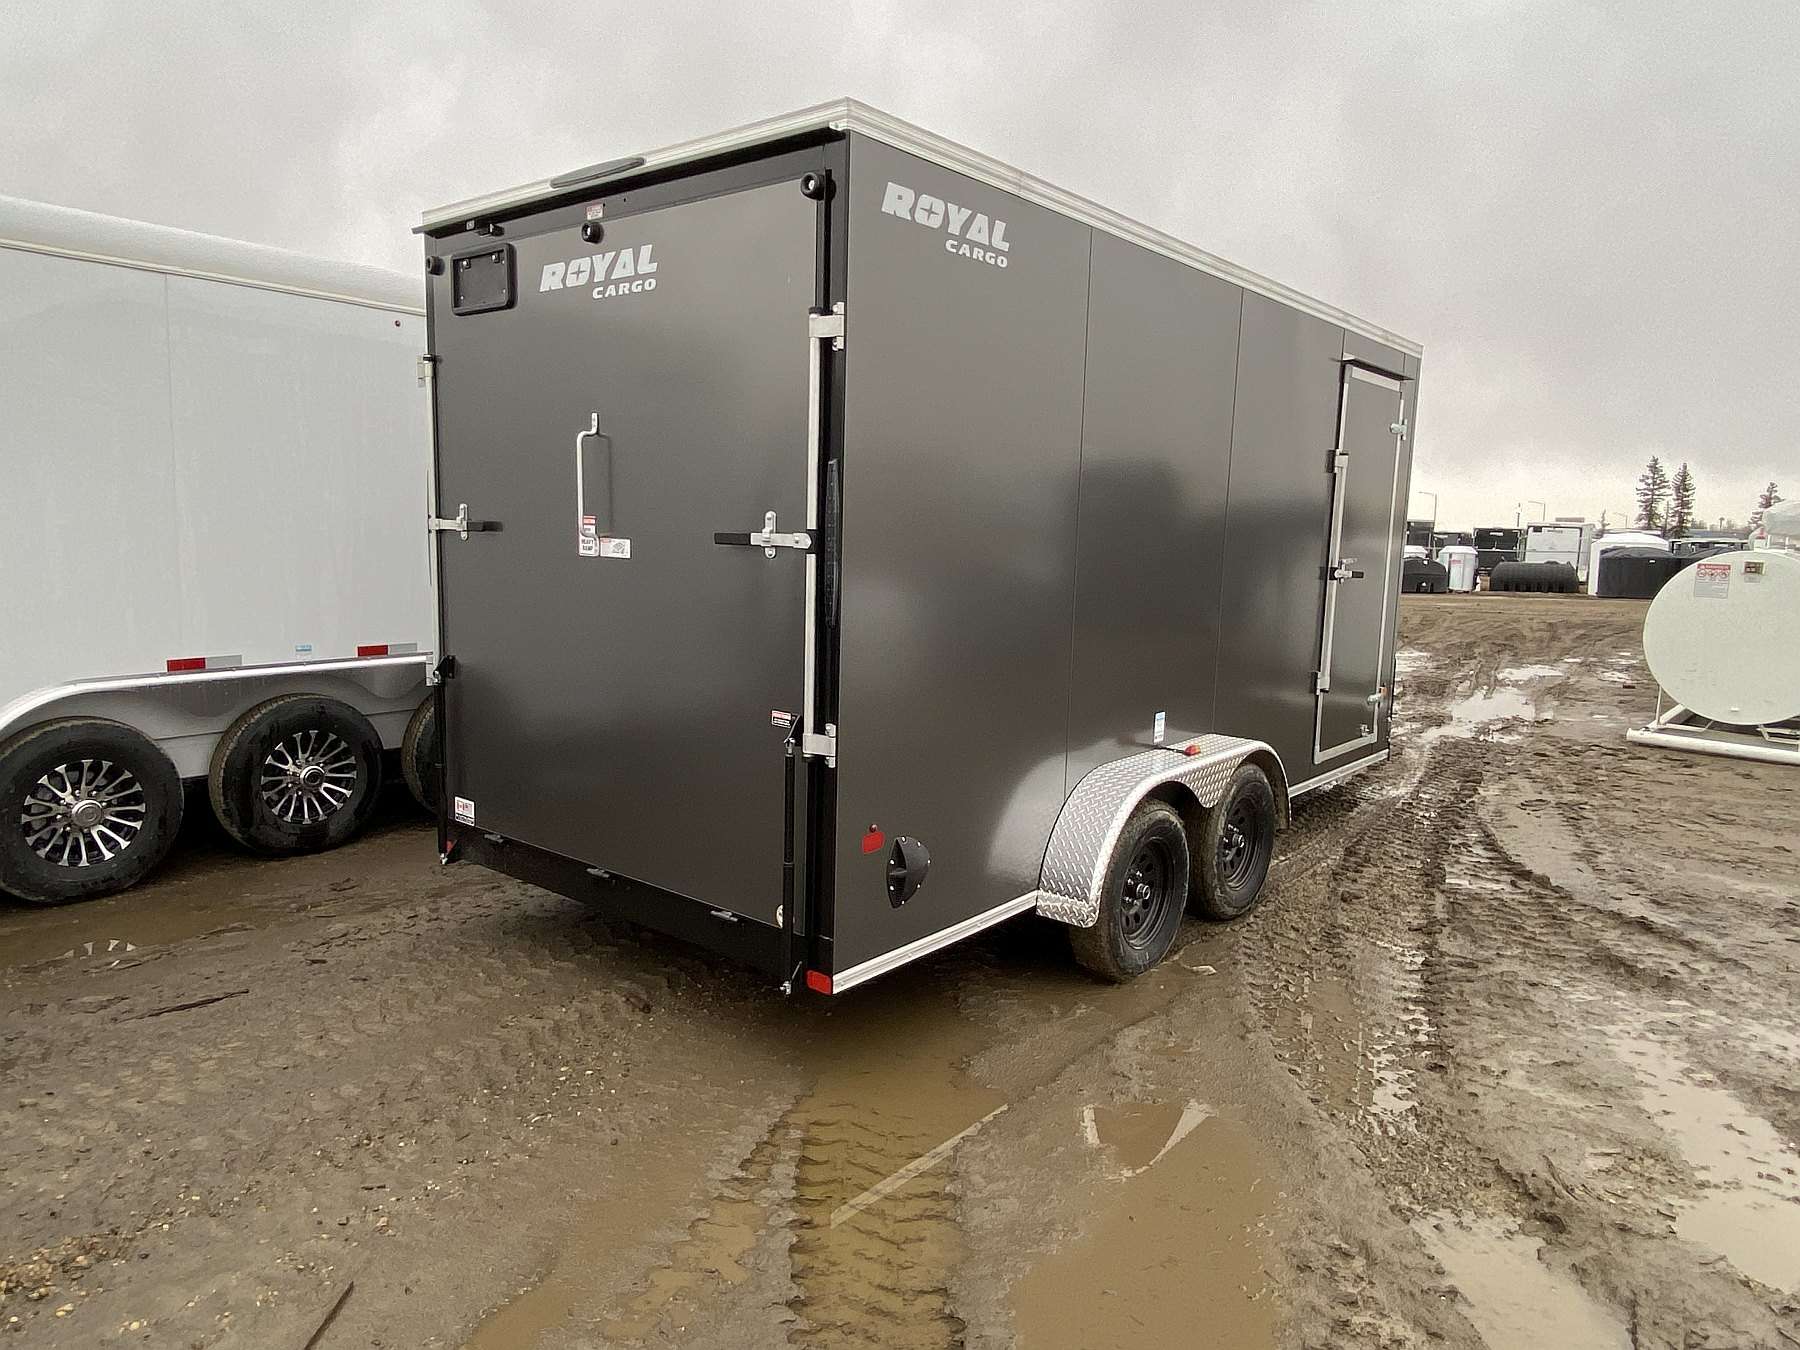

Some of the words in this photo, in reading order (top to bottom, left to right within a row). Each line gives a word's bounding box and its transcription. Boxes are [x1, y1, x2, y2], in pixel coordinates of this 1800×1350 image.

[881, 181, 1010, 252] ROYAL
[539, 244, 658, 292] ROYAL
[945, 239, 1008, 268] CARGO
[592, 278, 657, 299] CARGO
